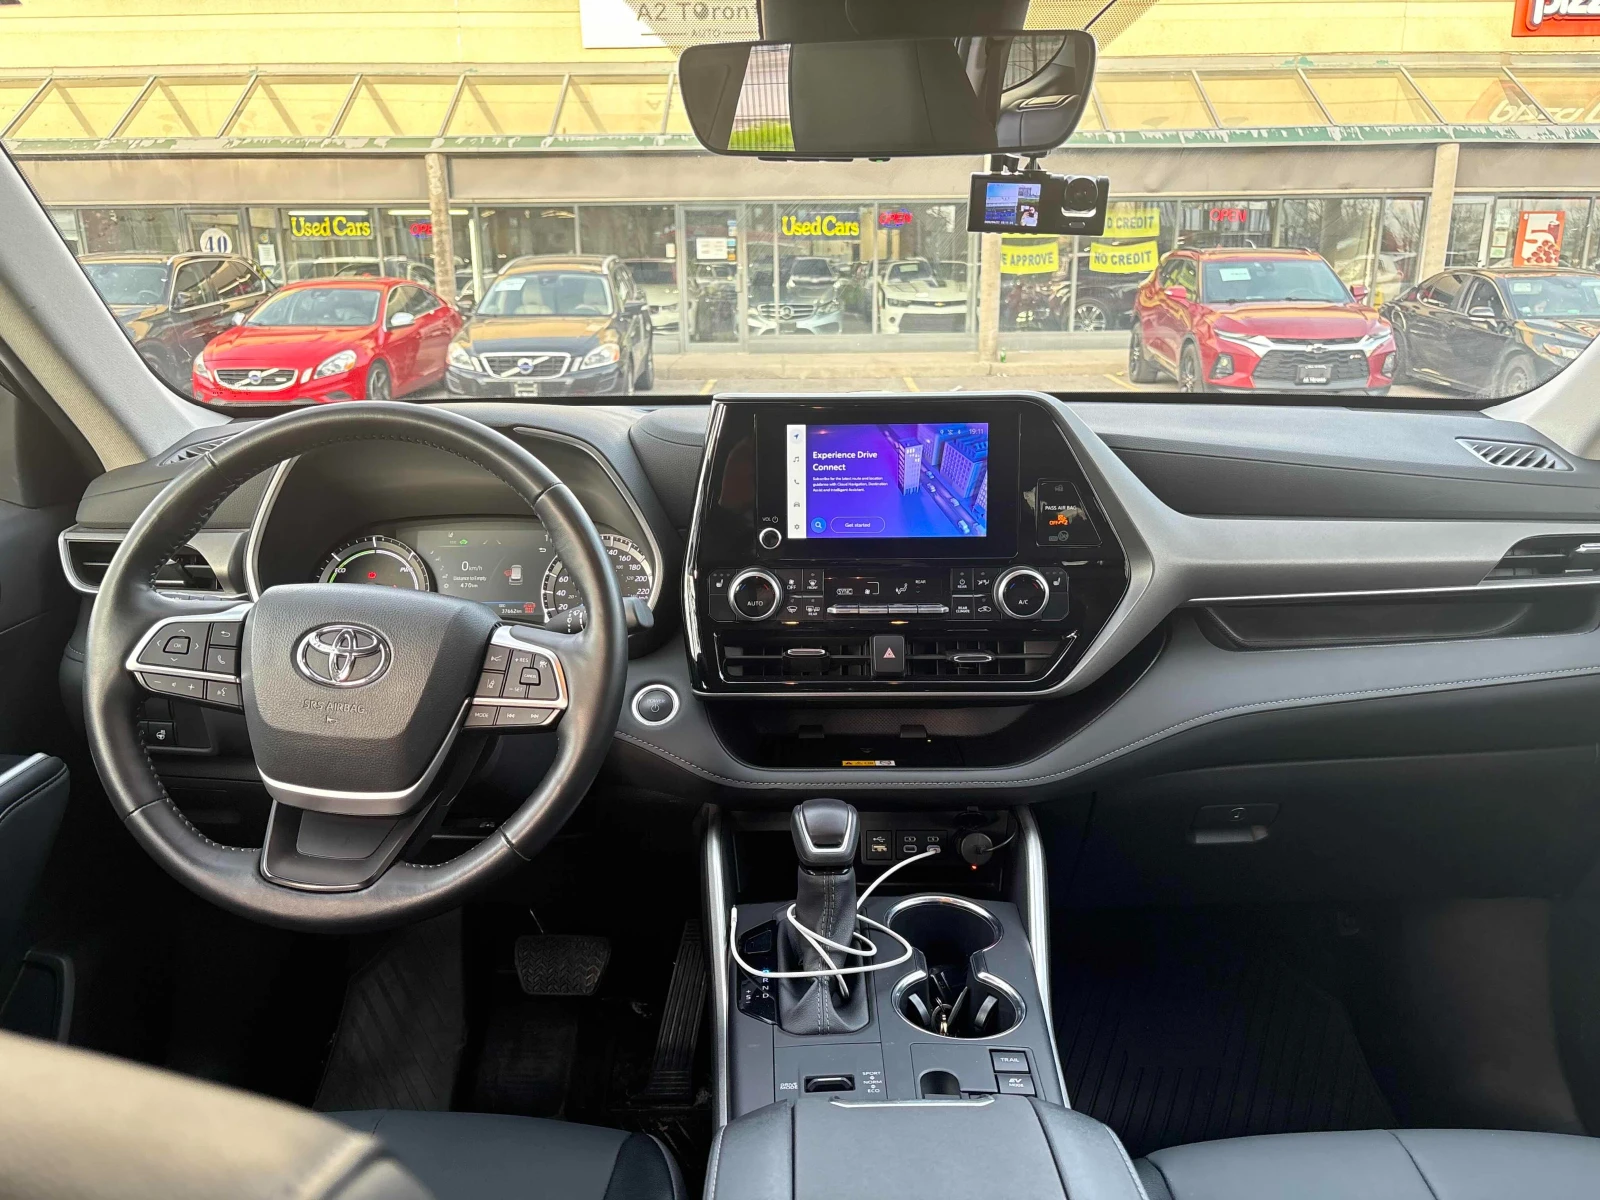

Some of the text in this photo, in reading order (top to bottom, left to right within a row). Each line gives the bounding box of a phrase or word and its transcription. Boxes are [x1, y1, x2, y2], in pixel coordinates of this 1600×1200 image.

[637, 3, 668, 21] A2
[879, 211, 913, 225] OPEN
[1209, 207, 1247, 222] OPEN
[291, 216, 371, 237] Used Cars
[409, 222, 432, 236] OPE
[781, 215, 860, 236] Used Cars
[1116, 216, 1154, 229] CREDIT
[205, 236, 227, 253] 40
[1010, 252, 1054, 266] APPROVE
[1094, 250, 1152, 265] NO CREDIT
[812, 450, 878, 460] Experience Drive
[812, 463, 847, 471] Connect
[461, 560, 469, 571] 0
[302, 699, 365, 714] SRS AIRBAG
